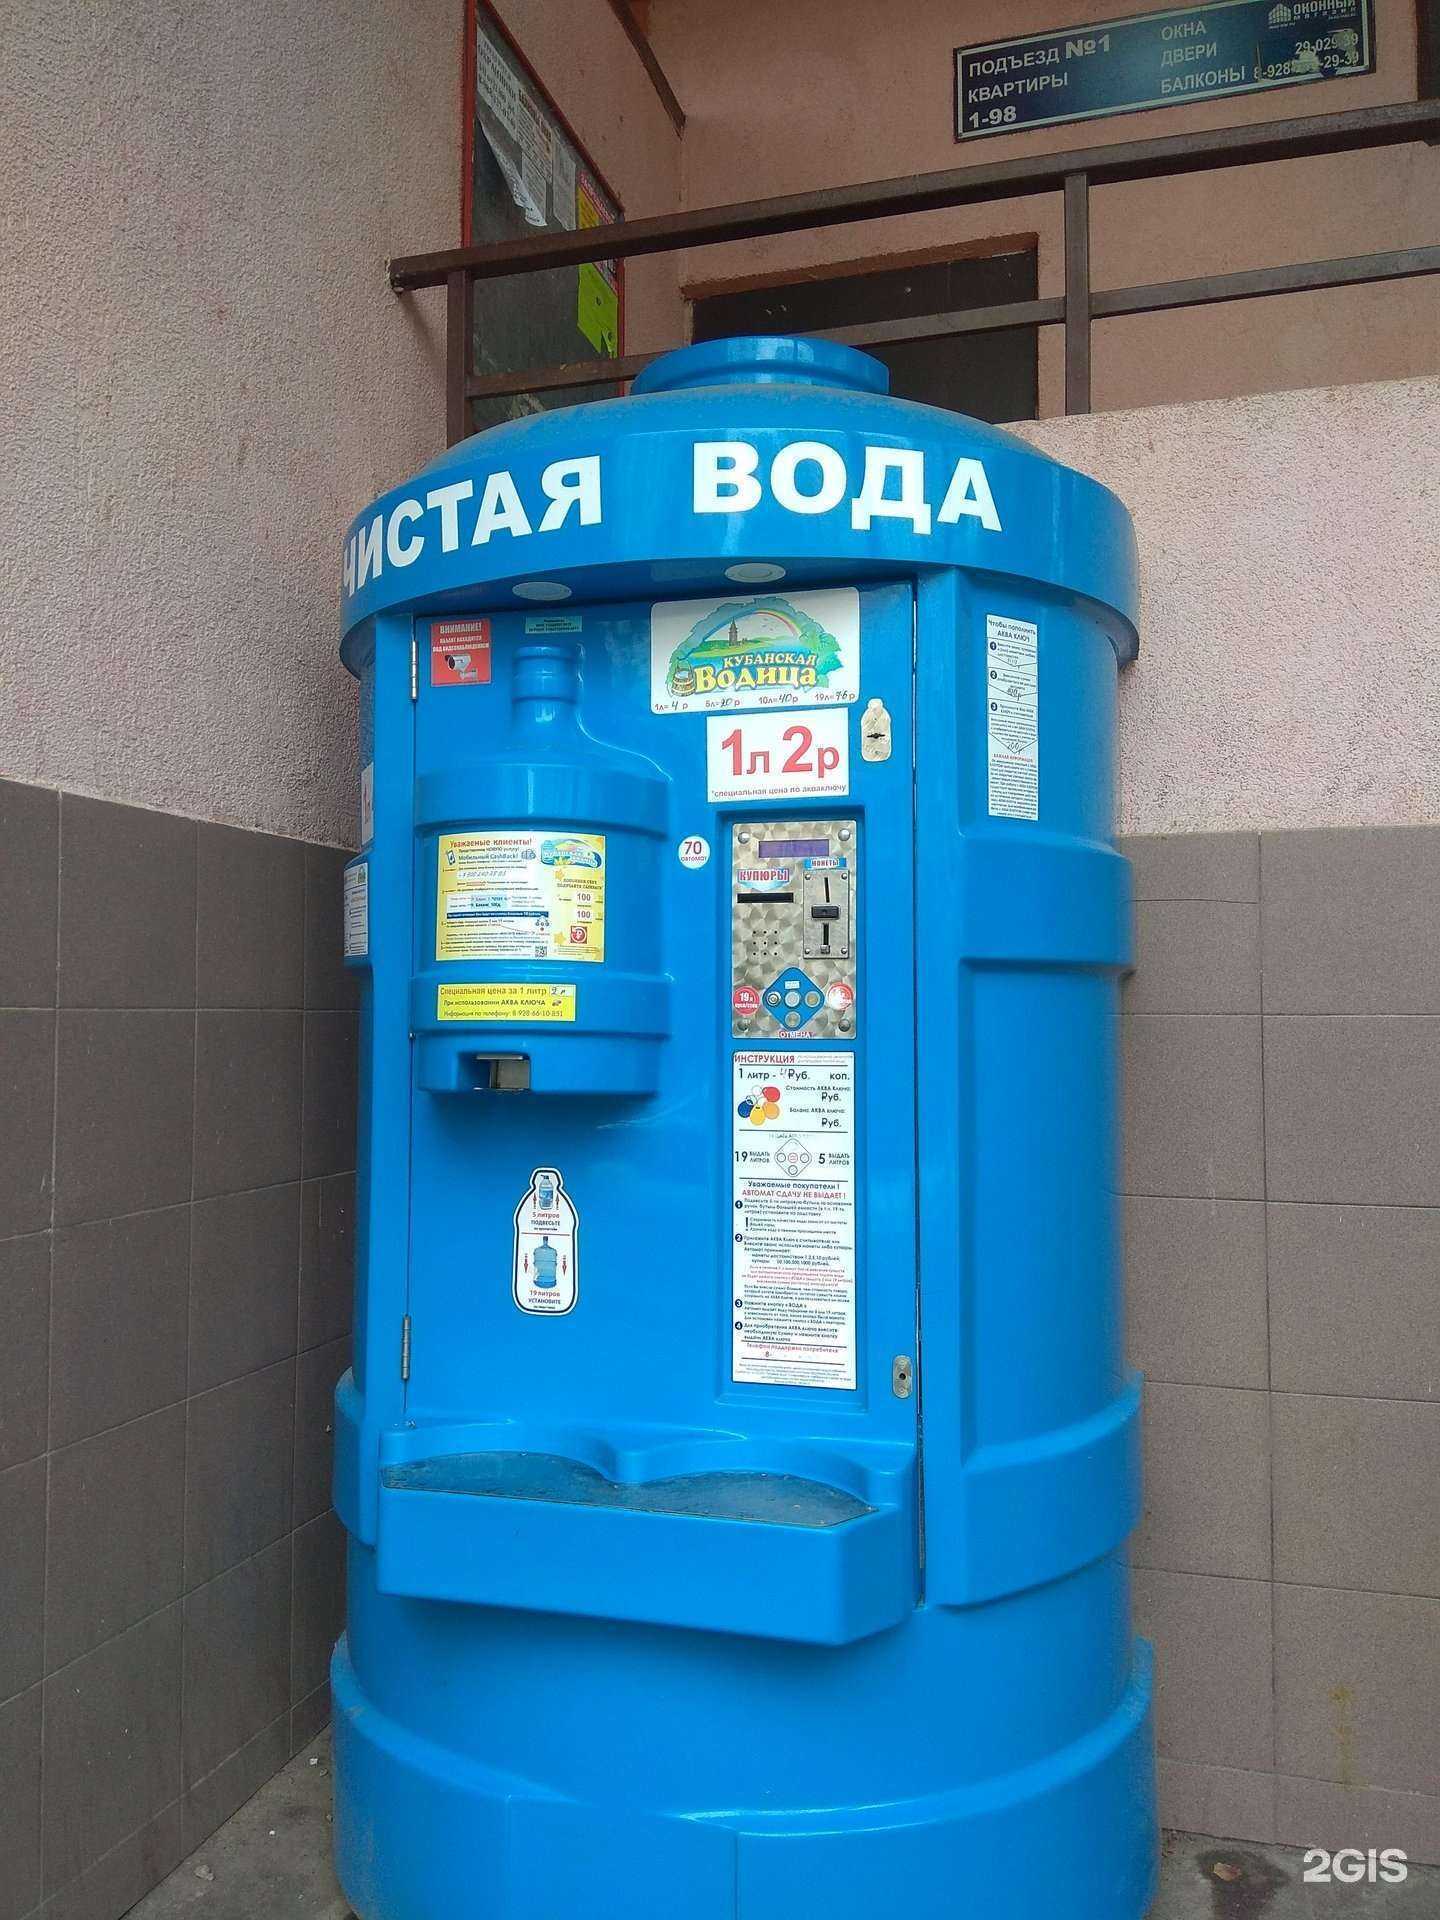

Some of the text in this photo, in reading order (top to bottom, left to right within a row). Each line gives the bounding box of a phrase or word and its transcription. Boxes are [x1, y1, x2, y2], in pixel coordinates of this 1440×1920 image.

[1161, 21, 1206, 42] ОКНА
[968, 34, 1112, 79] ПОДЪЕЗД №1
[1161, 43, 1217, 68] ДВЕРИ
[1161, 66, 1246, 95] БАЛКОНЫ
[968, 73, 1069, 104] КВАРТИРЫ
[968, 105, 1017, 129] 1-98
[343, 440, 1002, 598] ЧИСТАЯ ВОДА
[440, 622, 482, 634] ВНИМАНИЕ!
[723, 653, 817, 668] КУБАНСКАЯ
[721, 725, 841, 778] 1л 2р
[768, 787, 788, 796] цена
[684, 840, 703, 855] 70
[739, 870, 787, 881] КУПЮРЫ
[577, 893, 591, 902] 100
[440, 987, 485, 995] Специальная
[526, 988, 546, 996] литр
[779, 1031, 811, 1039] ОТМЕНА
[734, 1055, 795, 1063] ИНСТРУКЦИЯ
[739, 1068, 743, 1079] 1
[747, 1072, 770, 1080] литр
[735, 1151, 748, 1162] 19
[818, 1154, 825, 1164] 5
[748, 1181, 790, 1189] Уважаемые
[776, 1190, 801, 1198] СДАЧУ
[814, 1191, 842, 1199] ВЫДАЕТ
